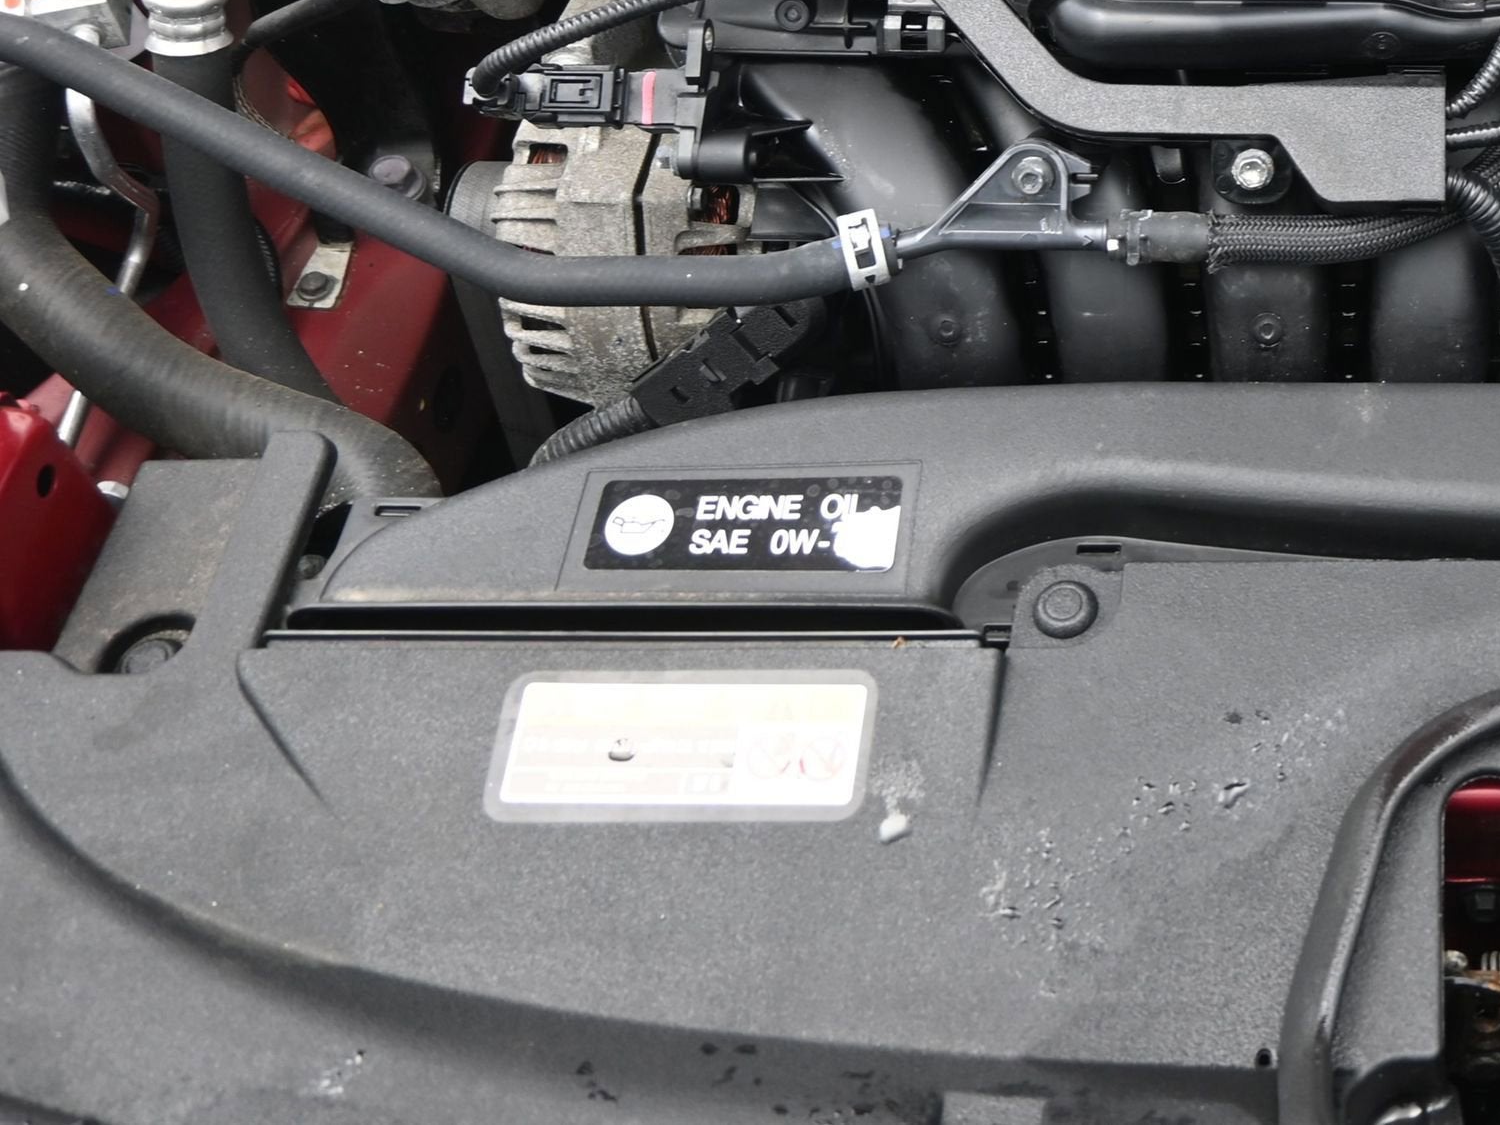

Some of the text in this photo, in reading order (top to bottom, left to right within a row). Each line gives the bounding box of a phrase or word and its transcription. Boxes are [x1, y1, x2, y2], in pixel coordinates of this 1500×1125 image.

[695, 493, 862, 521] ENGINE OIL
[688, 524, 870, 556] SAE 0W-
